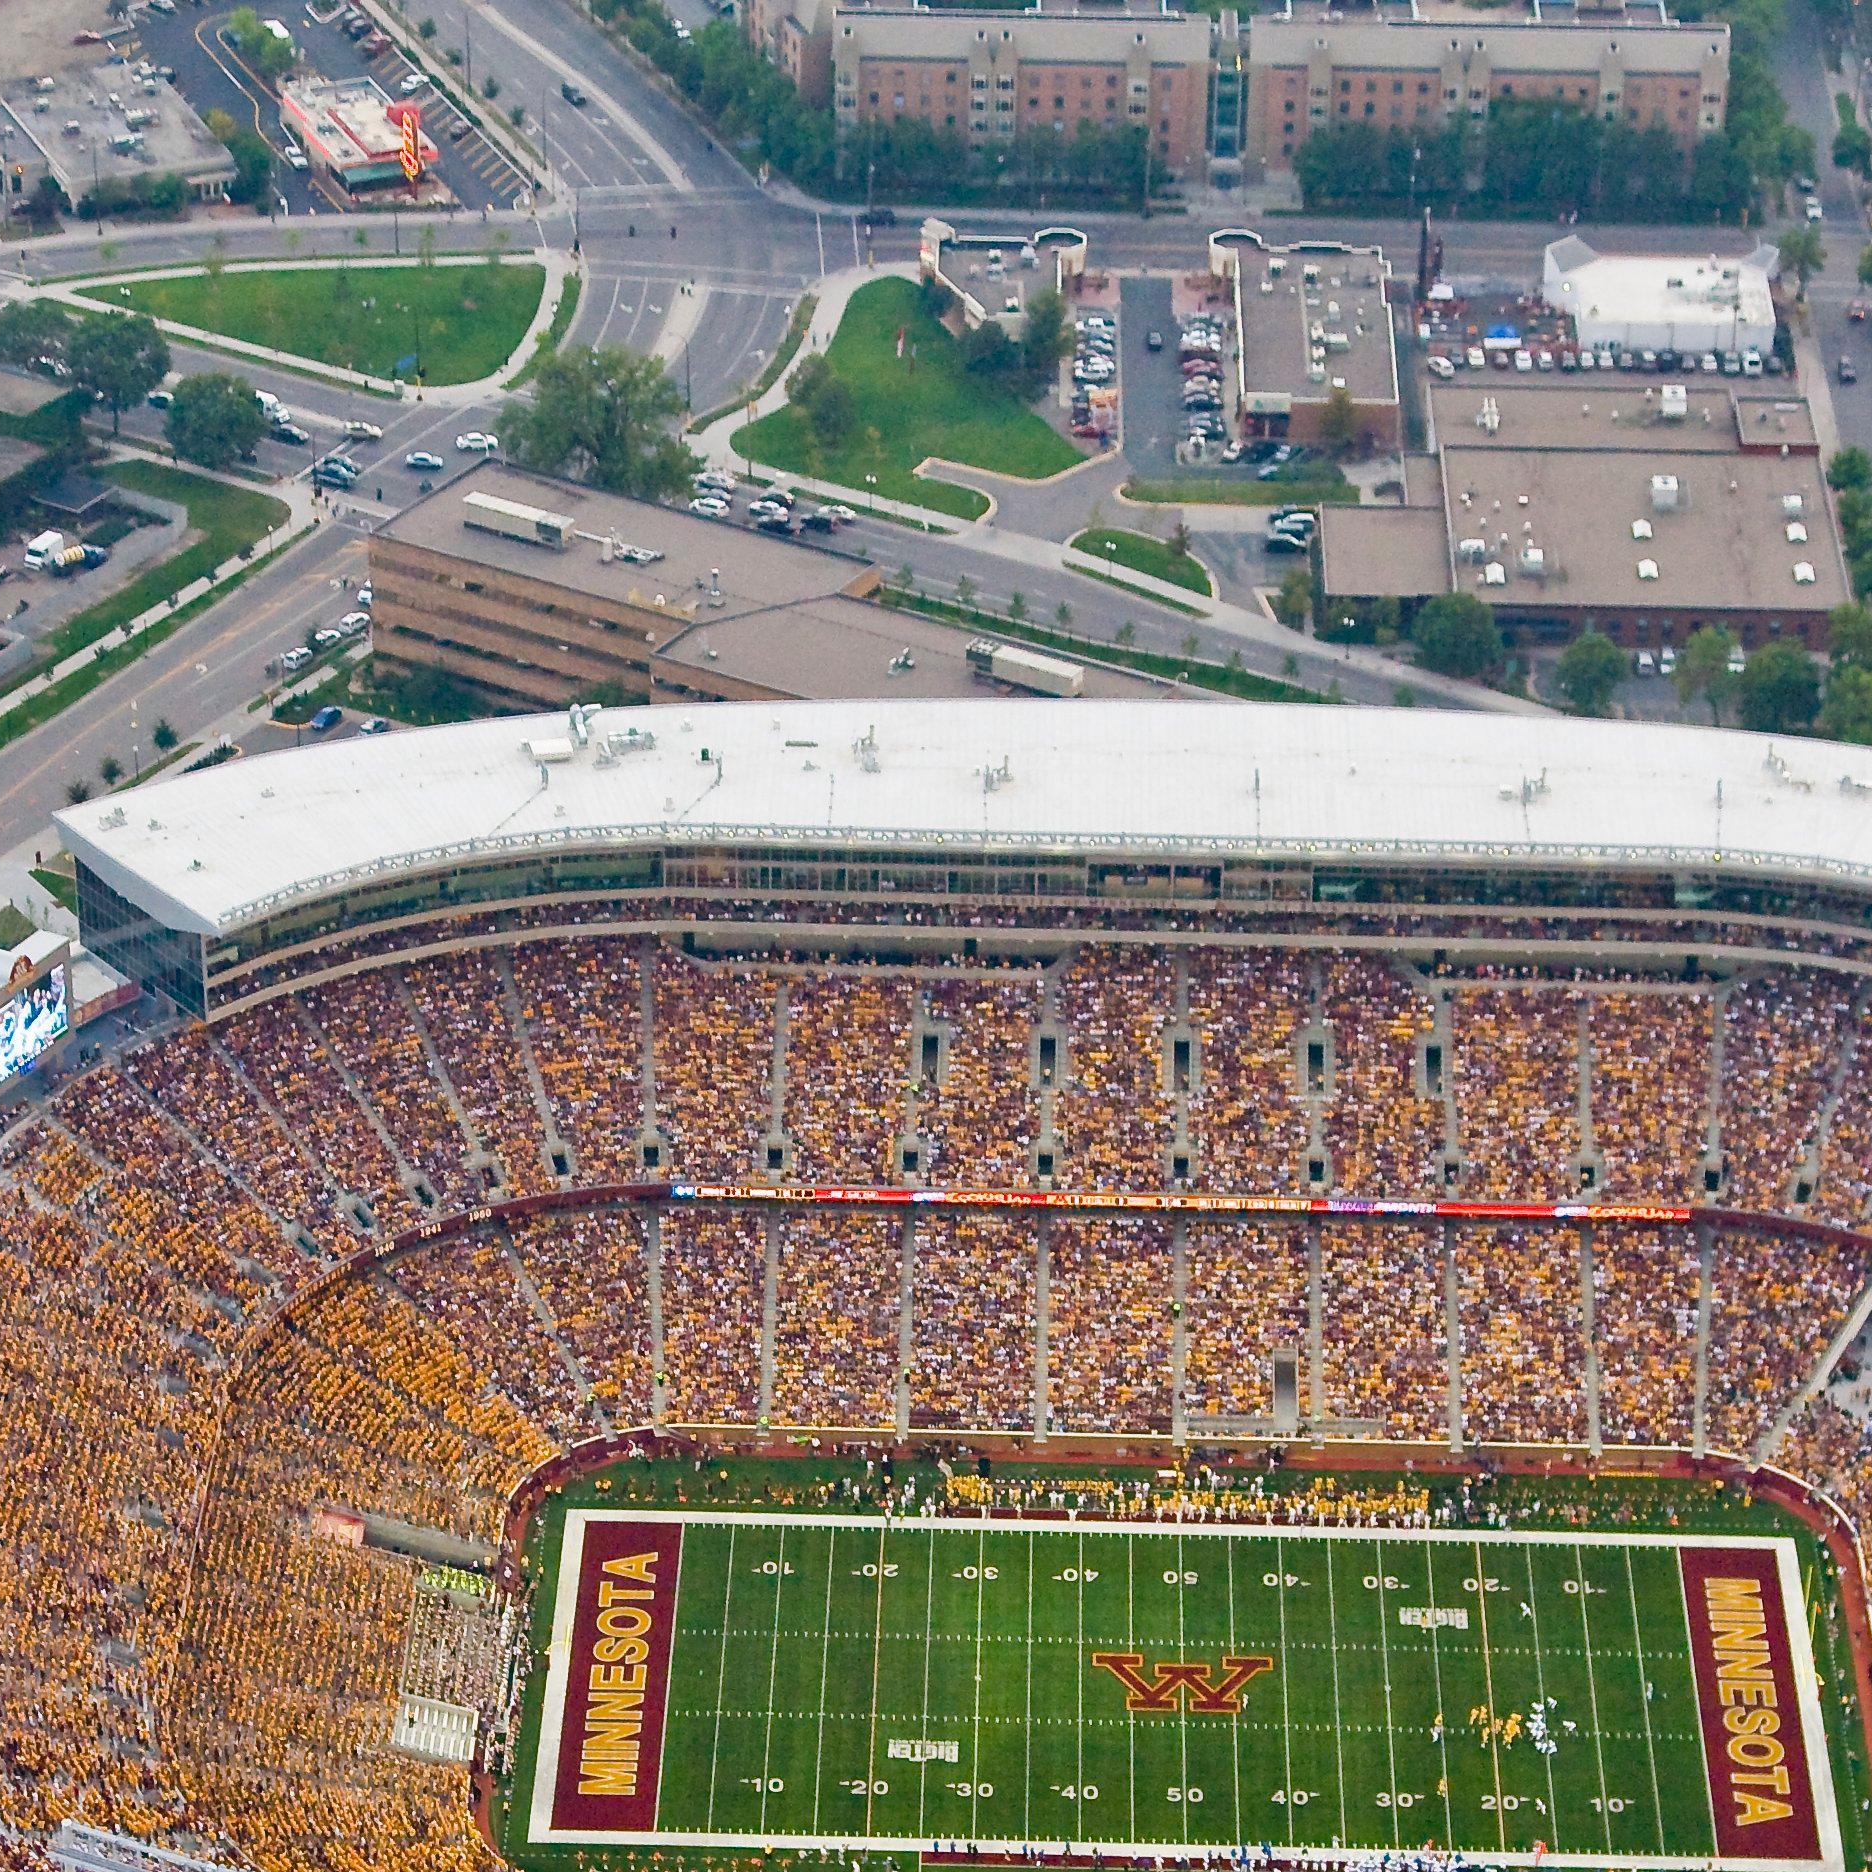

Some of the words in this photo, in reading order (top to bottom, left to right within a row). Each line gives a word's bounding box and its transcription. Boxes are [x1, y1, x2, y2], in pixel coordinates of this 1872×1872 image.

[762, 1561, 794, 1575] 10
[862, 1563, 898, 1578] 20
[962, 1566, 999, 1580] 30
[1062, 1568, 1098, 1582] 40
[1163, 1570, 1198, 1585] 50
[1262, 1573, 1299, 1587] 40
[1363, 1575, 1399, 1589] 30
[1463, 1578, 1500, 1592] 20
[1564, 1579, 1596, 1594] 10
[578, 1552, 659, 1796] MINNESOTA
[1705, 1577, 1794, 1826] MINNESOTA
[751, 1778, 784, 1793] 10
[850, 1780, 889, 1795] 20
[956, 1783, 994, 1798] 30
[1061, 1785, 1099, 1800] 40
[1166, 1787, 1204, 1803] 50
[1271, 1789, 1309, 1805] 40
[1376, 1792, 1414, 1808] 30
[1481, 1795, 1519, 1811] 20
[1591, 1797, 1625, 1813] 10
